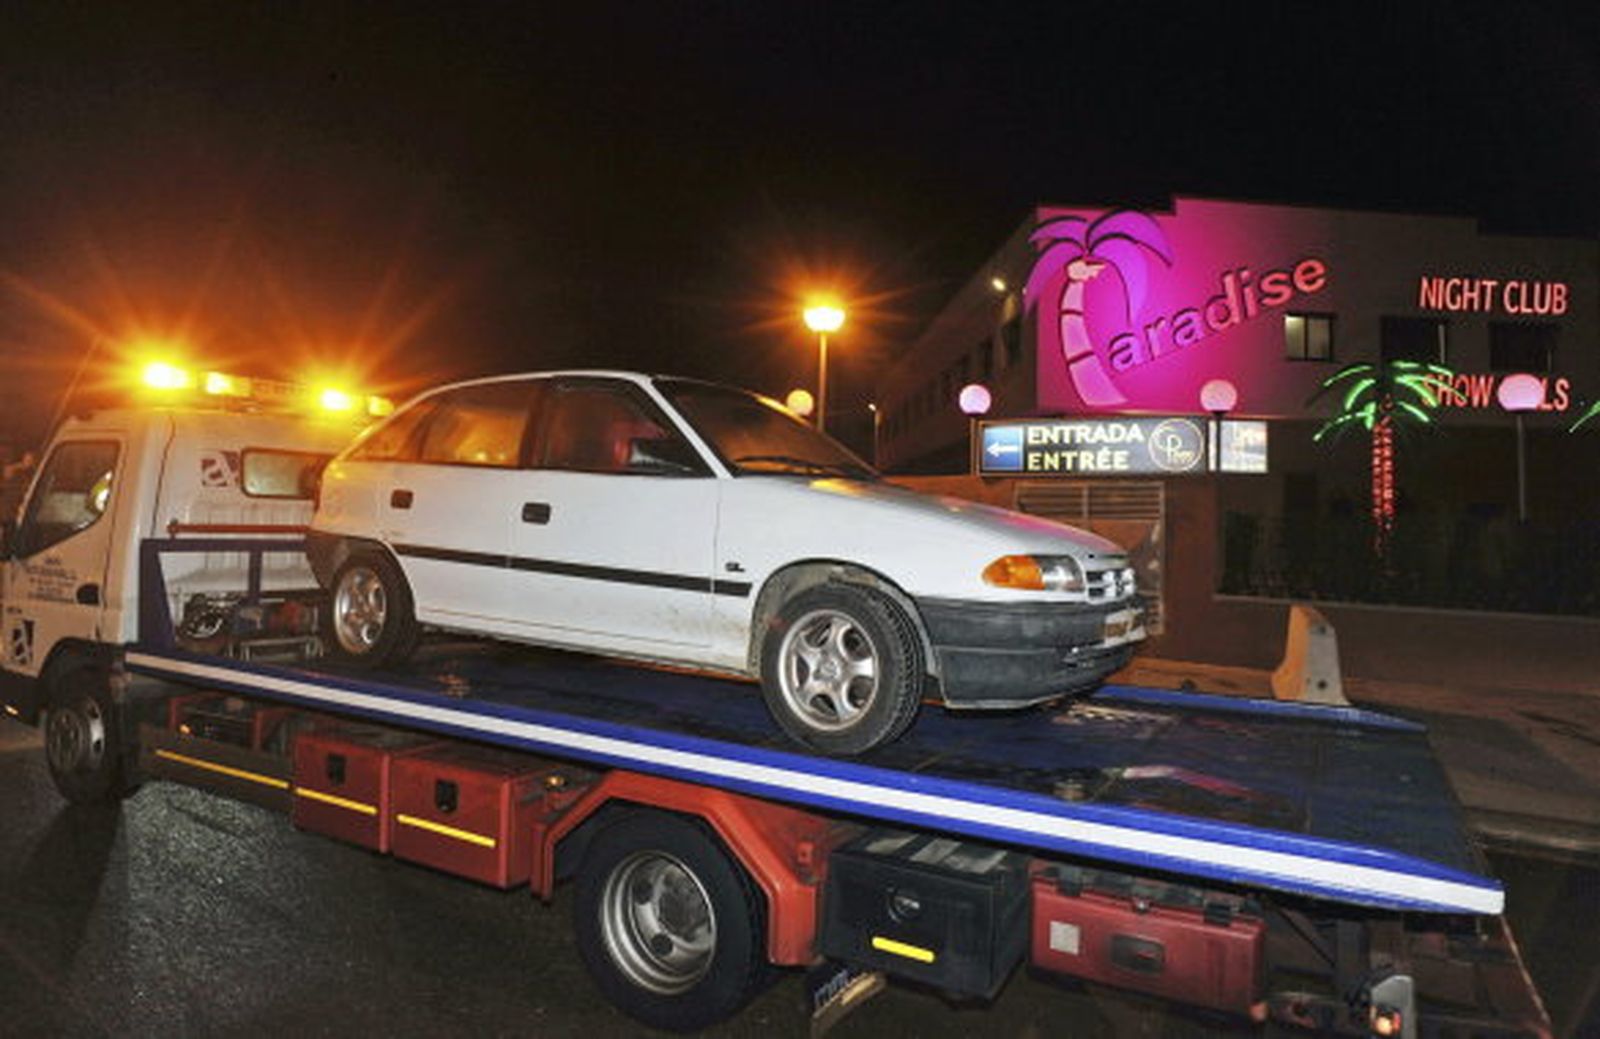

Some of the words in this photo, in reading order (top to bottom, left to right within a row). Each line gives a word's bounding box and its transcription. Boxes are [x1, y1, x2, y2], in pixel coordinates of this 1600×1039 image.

[1419, 276, 1498, 312] NIGHT
[1503, 281, 1568, 315] CLUB
[1027, 424, 1146, 444] ENTRADA
[1027, 446, 1130, 471] ENTRÉE
